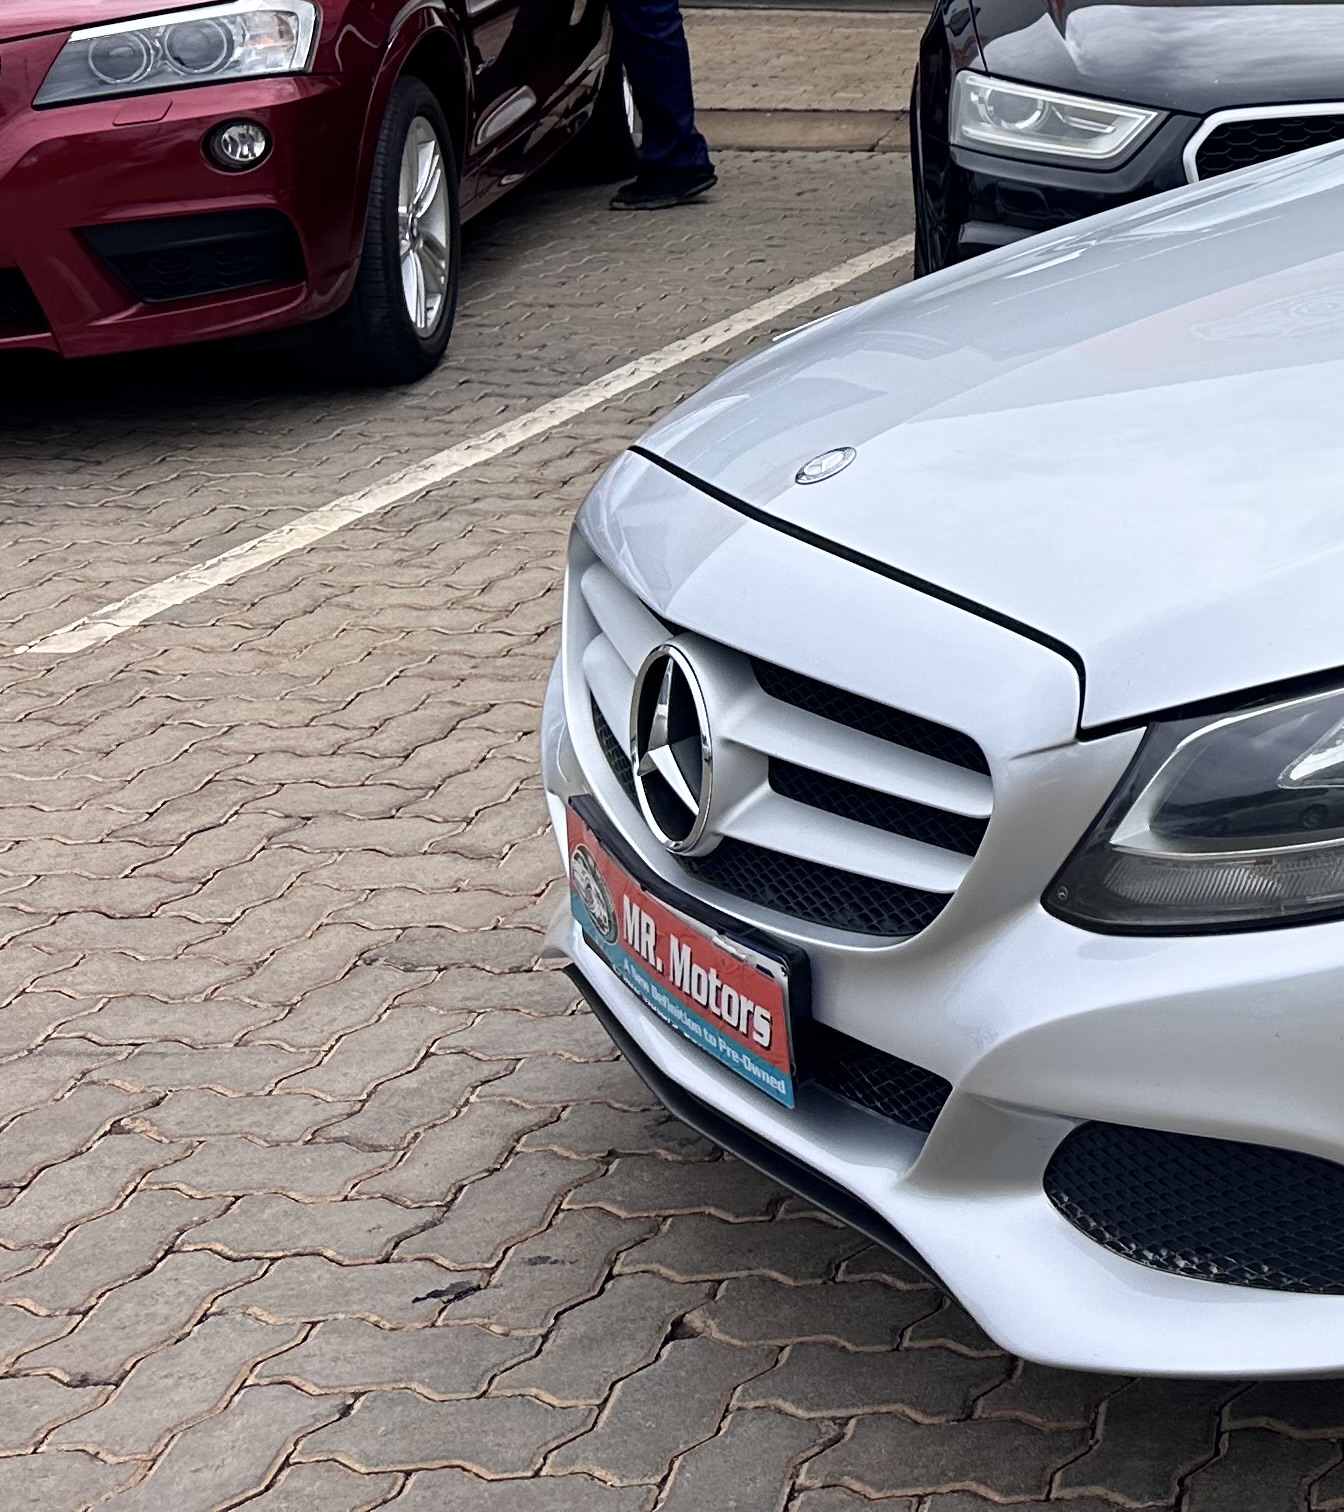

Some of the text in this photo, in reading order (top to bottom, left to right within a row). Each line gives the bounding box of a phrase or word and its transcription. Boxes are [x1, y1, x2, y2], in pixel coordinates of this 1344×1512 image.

[622, 894, 663, 973] MR.
[669, 934, 773, 1049] Motors
[703, 1027, 718, 1048] to
[718, 1036, 787, 1095] Pre-Owned
